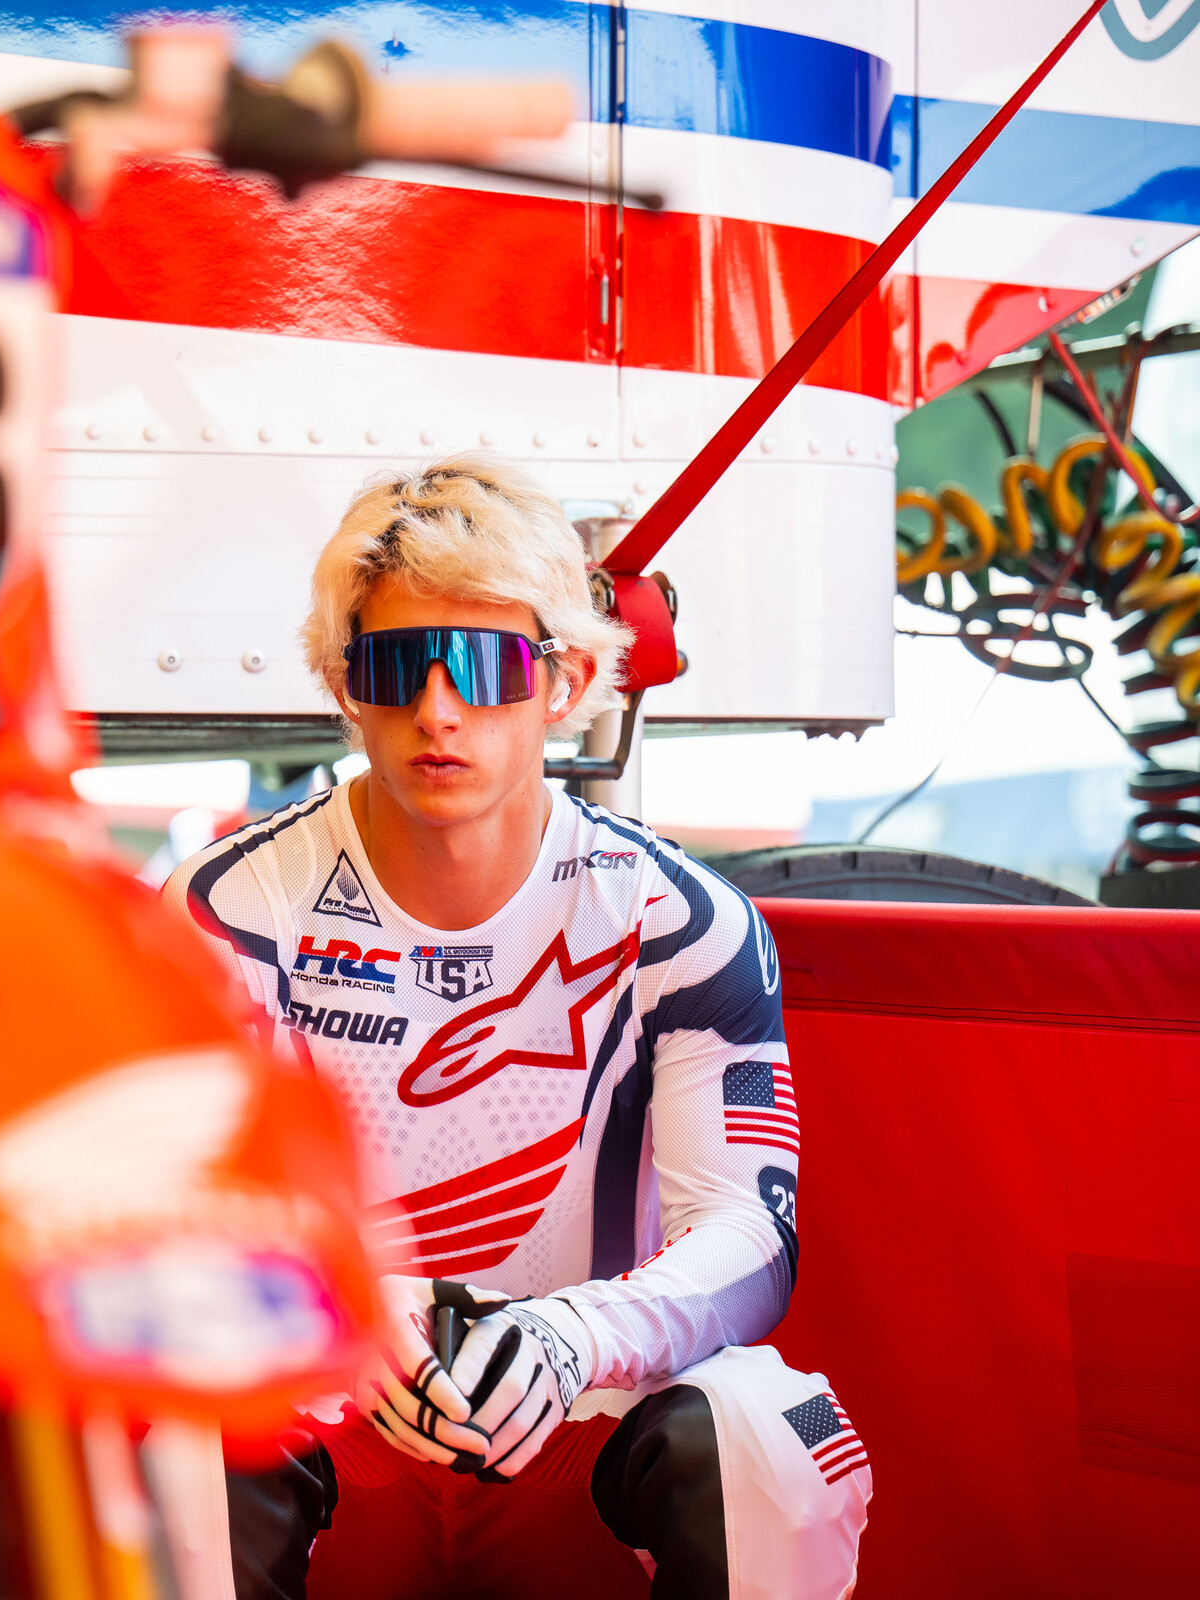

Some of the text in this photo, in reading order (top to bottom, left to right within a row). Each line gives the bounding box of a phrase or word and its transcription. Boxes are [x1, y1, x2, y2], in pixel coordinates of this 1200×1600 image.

[293, 935, 402, 985] HRC
[408, 945, 444, 958] AMA
[290, 970, 396, 995] Honda RACING
[416, 960, 493, 1002] USA
[280, 1000, 409, 1046] SHOWA
